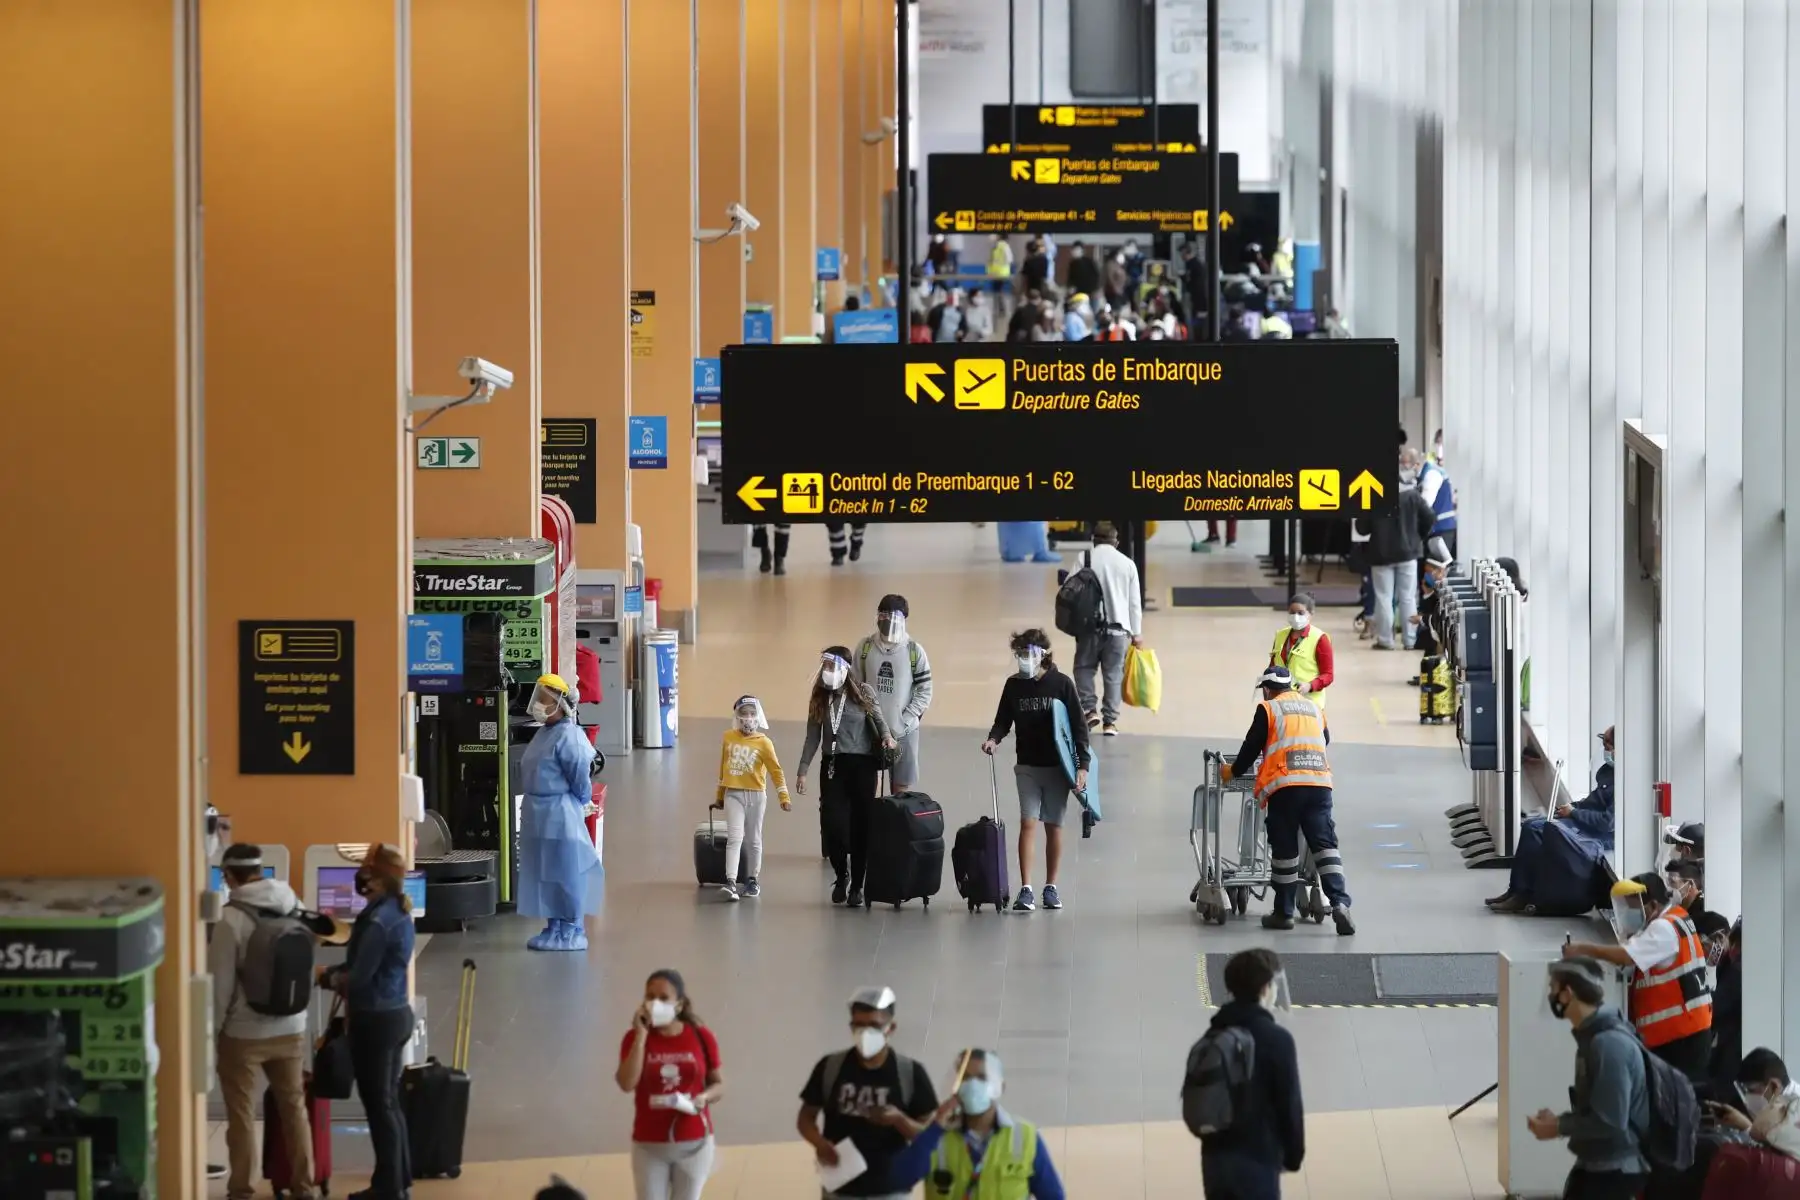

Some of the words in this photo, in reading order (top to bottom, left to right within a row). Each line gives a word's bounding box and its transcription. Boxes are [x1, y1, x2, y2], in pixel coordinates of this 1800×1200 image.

[1012, 358, 1085, 382] Puertas
[1092, 357, 1116, 381] de
[1123, 357, 1222, 385] Embarque
[1011, 391, 1090, 413] Departure
[1095, 390, 1140, 410] Gates
[829, 472, 886, 492] Control
[892, 472, 911, 490] de
[917, 472, 1020, 494] Preembarque
[1026, 472, 1033, 489] 1
[1053, 472, 1074, 490] 62
[1132, 470, 1202, 493] Llegadas
[1207, 469, 1294, 489] Nacionales
[829, 498, 868, 514] Check
[872, 498, 884, 513] In
[888, 498, 896, 513] 1
[910, 498, 928, 513] 62
[1184, 496, 1244, 512] Domestic
[1246, 496, 1294, 511] Arrivals
[425, 574, 507, 591] TrueStar
[840, 1082, 890, 1115] CAT
